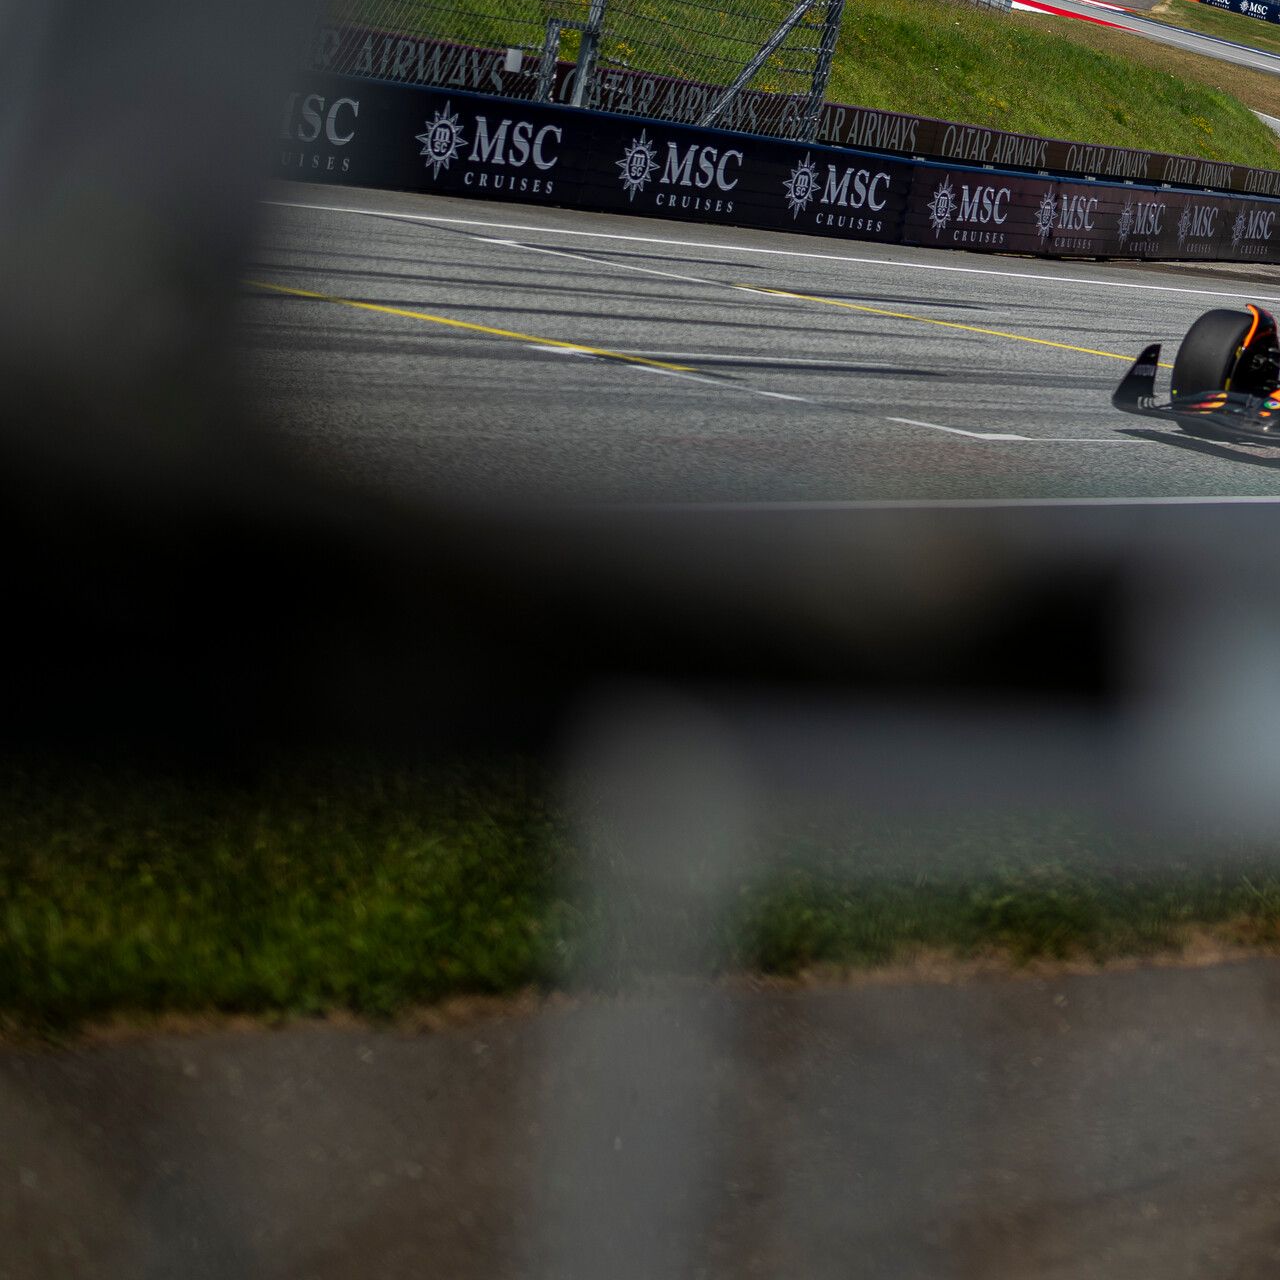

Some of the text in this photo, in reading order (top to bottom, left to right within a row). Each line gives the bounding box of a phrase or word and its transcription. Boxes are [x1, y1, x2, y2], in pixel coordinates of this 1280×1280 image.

[1249, 2, 1268, 15] MSC
[279, 91, 359, 146] SC
[846, 112, 919, 152] AIRWAYS
[468, 116, 562, 170] MSC
[941, 125, 1049, 168] QATAR AIRWAYS
[660, 142, 743, 191] MSC
[1066, 145, 1150, 178] QATAR AIRWAYS
[1163, 158, 1234, 189] QATAR AIRWAYS
[464, 172, 553, 194] CRUISES
[820, 164, 890, 212] MSC
[1244, 170, 1274, 194] QATAR
[656, 193, 734, 213] CRUISES
[956, 185, 1010, 224] MSC
[1057, 194, 1098, 232] MSC
[816, 212, 883, 232] CRUISES
[1133, 203, 1166, 235] MSC
[1190, 206, 1218, 237] MSC
[1245, 210, 1275, 240] MSC
[954, 230, 1004, 244] CRUISES
[1055, 237, 1091, 250] CRUISES
[1129, 242, 1159, 252] CRUISES
[1187, 244, 1211, 253] CRUISES
[1241, 245, 1268, 254] CRUISES
